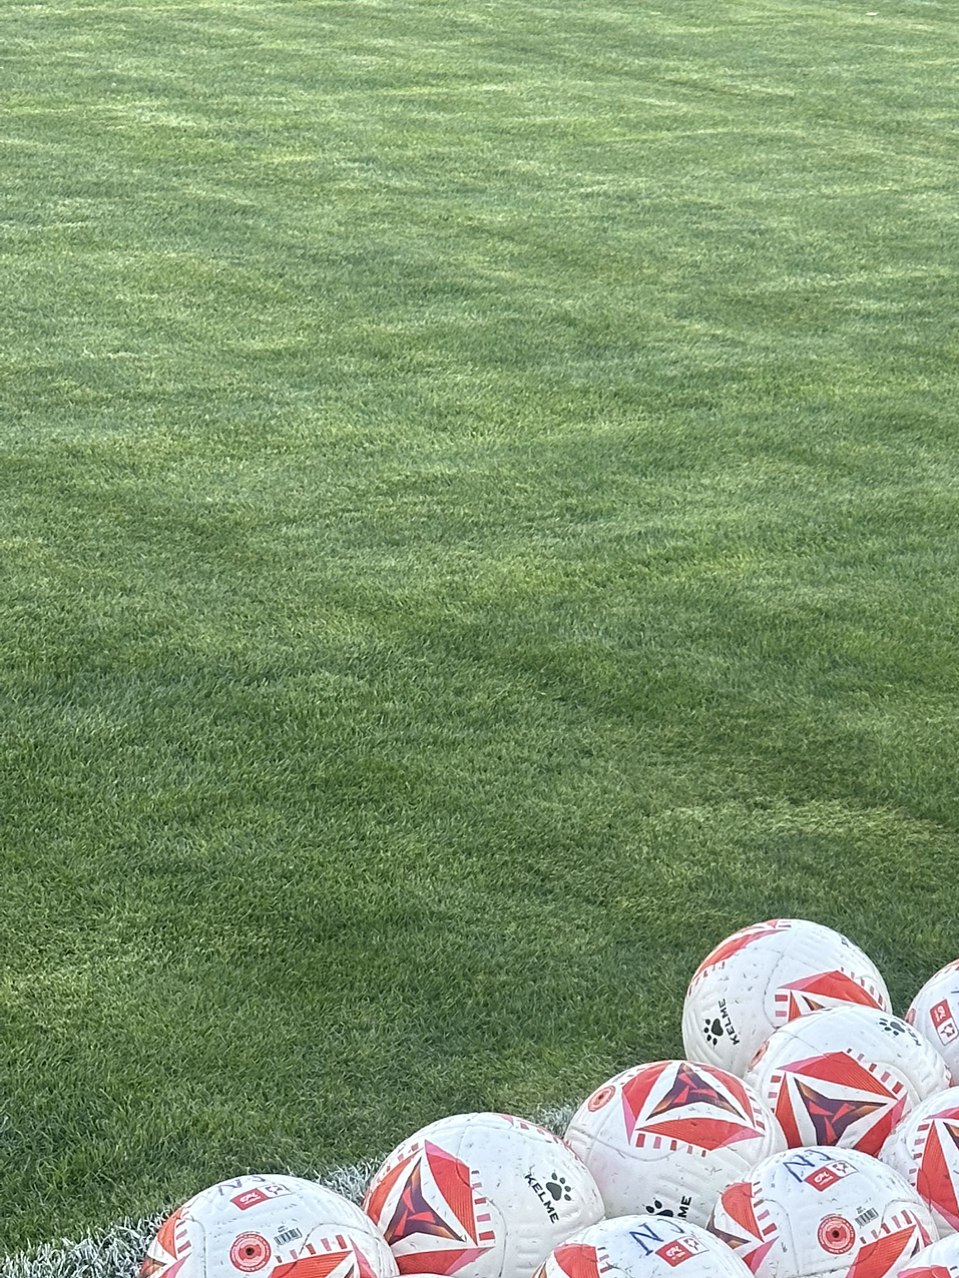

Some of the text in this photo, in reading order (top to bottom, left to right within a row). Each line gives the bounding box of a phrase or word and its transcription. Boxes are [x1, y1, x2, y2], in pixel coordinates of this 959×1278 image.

[718, 999, 740, 1046] KELME
[783, 1150, 836, 1183] NJ
[525, 1172, 560, 1224] KELME
[629, 1219, 685, 1256] NJ
